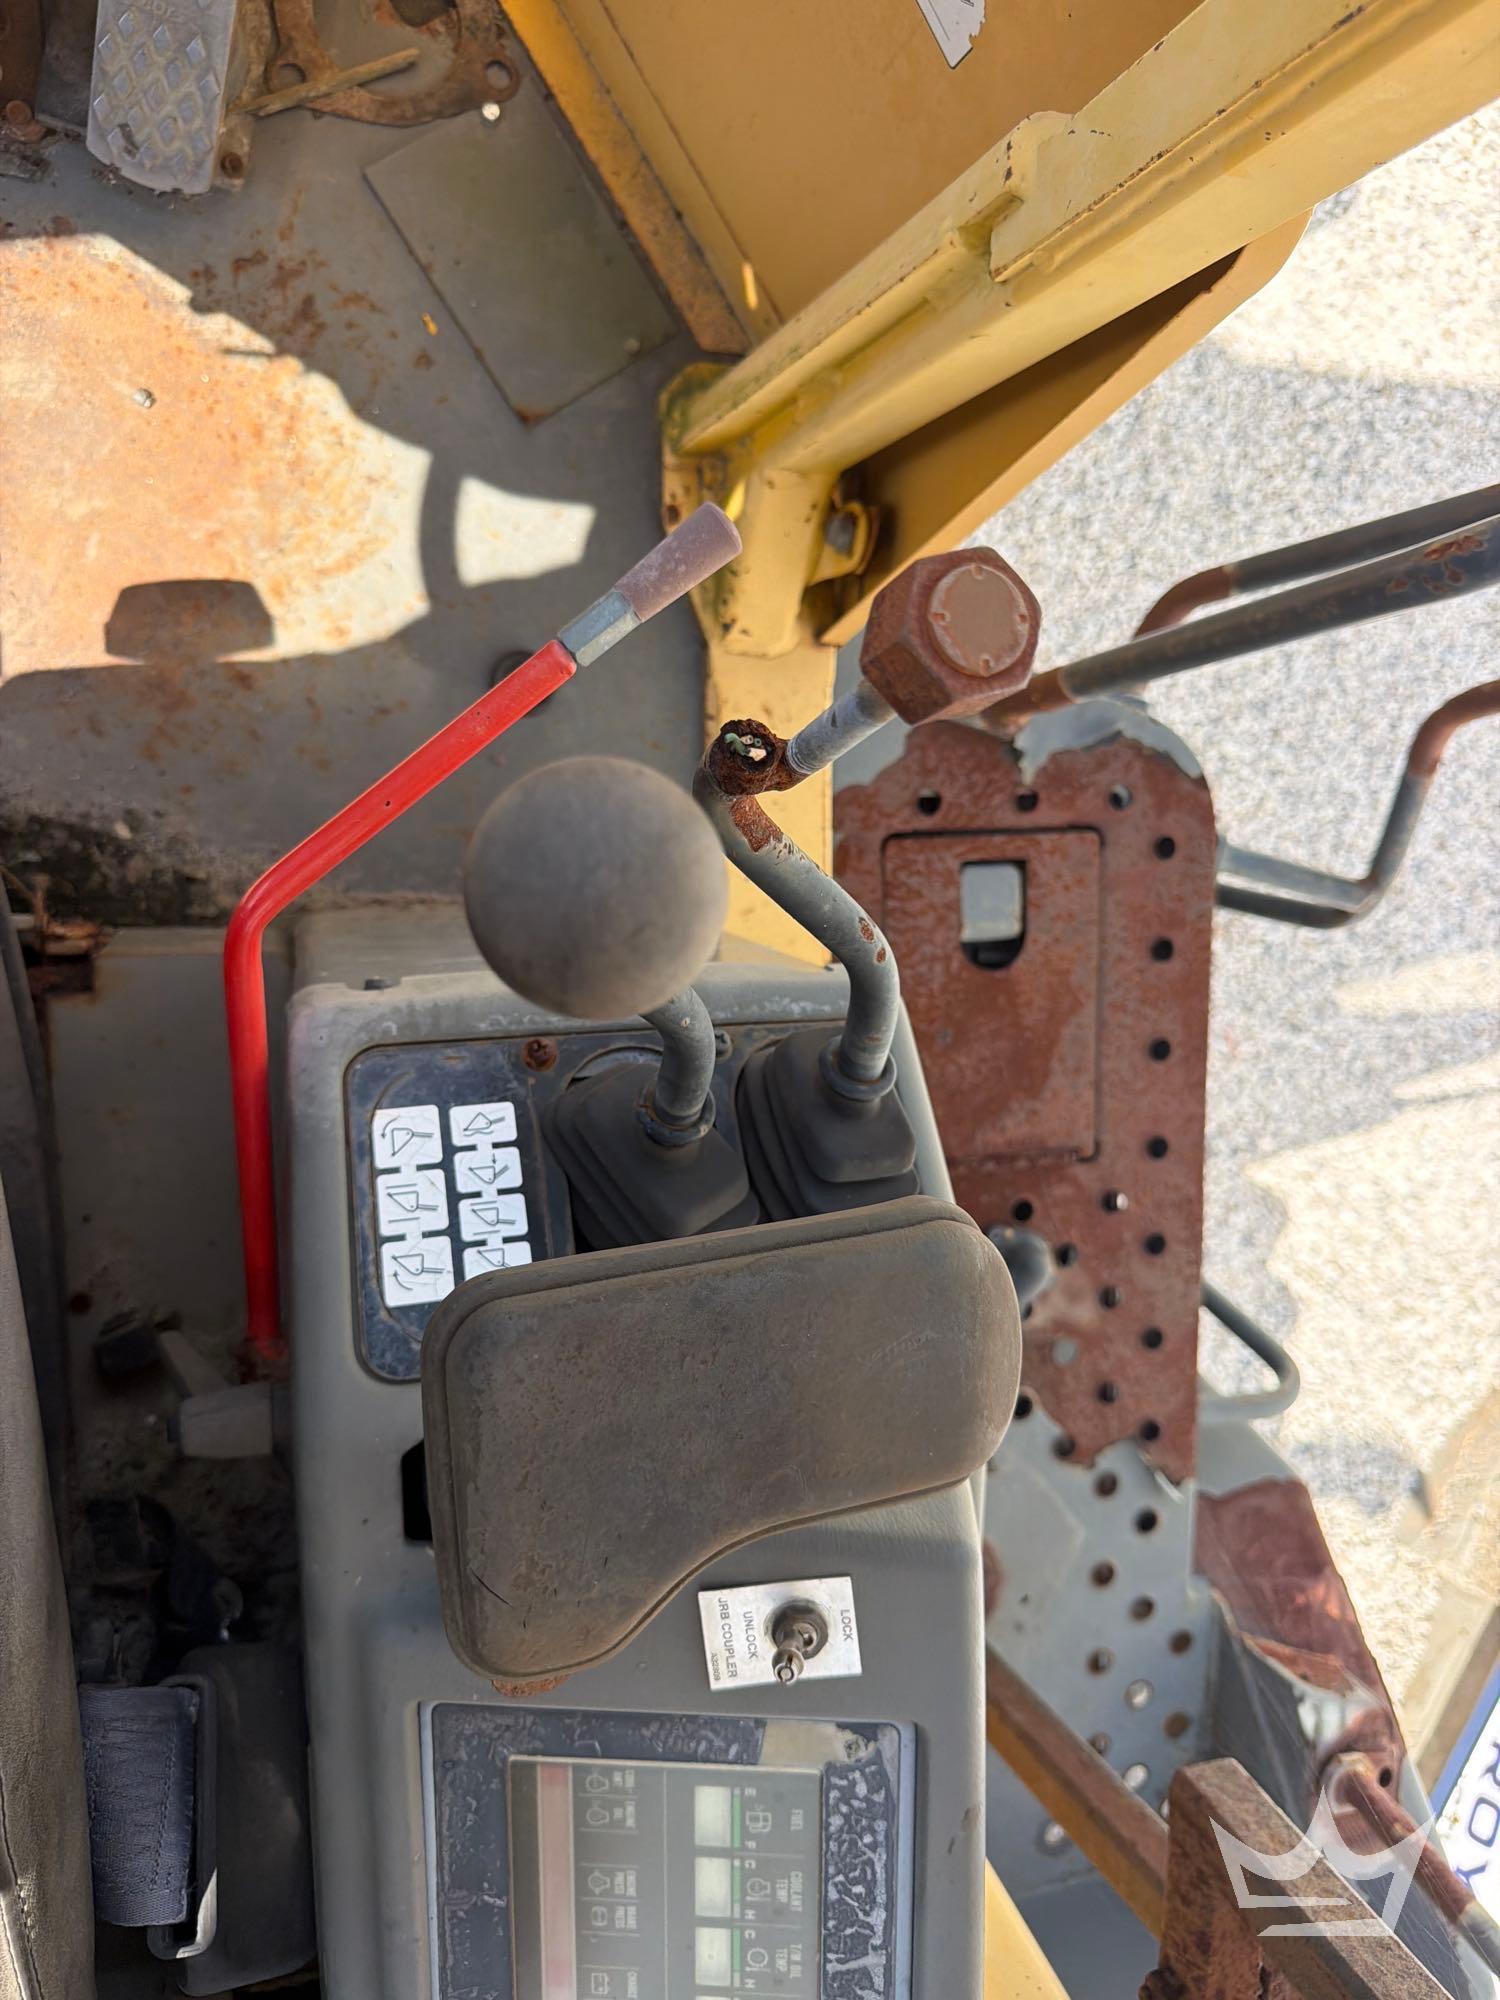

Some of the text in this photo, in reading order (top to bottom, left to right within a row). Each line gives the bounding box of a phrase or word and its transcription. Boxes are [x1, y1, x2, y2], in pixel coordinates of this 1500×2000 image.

[718, 1597, 738, 1678] JRB COUPLER
[743, 1611, 760, 1660] UNLOCK
[840, 1609, 854, 1641] LOCK
[744, 1787, 756, 1849] E F
[790, 1808, 803, 1831] FUEL
[744, 1859, 756, 1920] C H
[789, 1871, 803, 1911] COOLANT
[744, 1929, 756, 1989] C H
